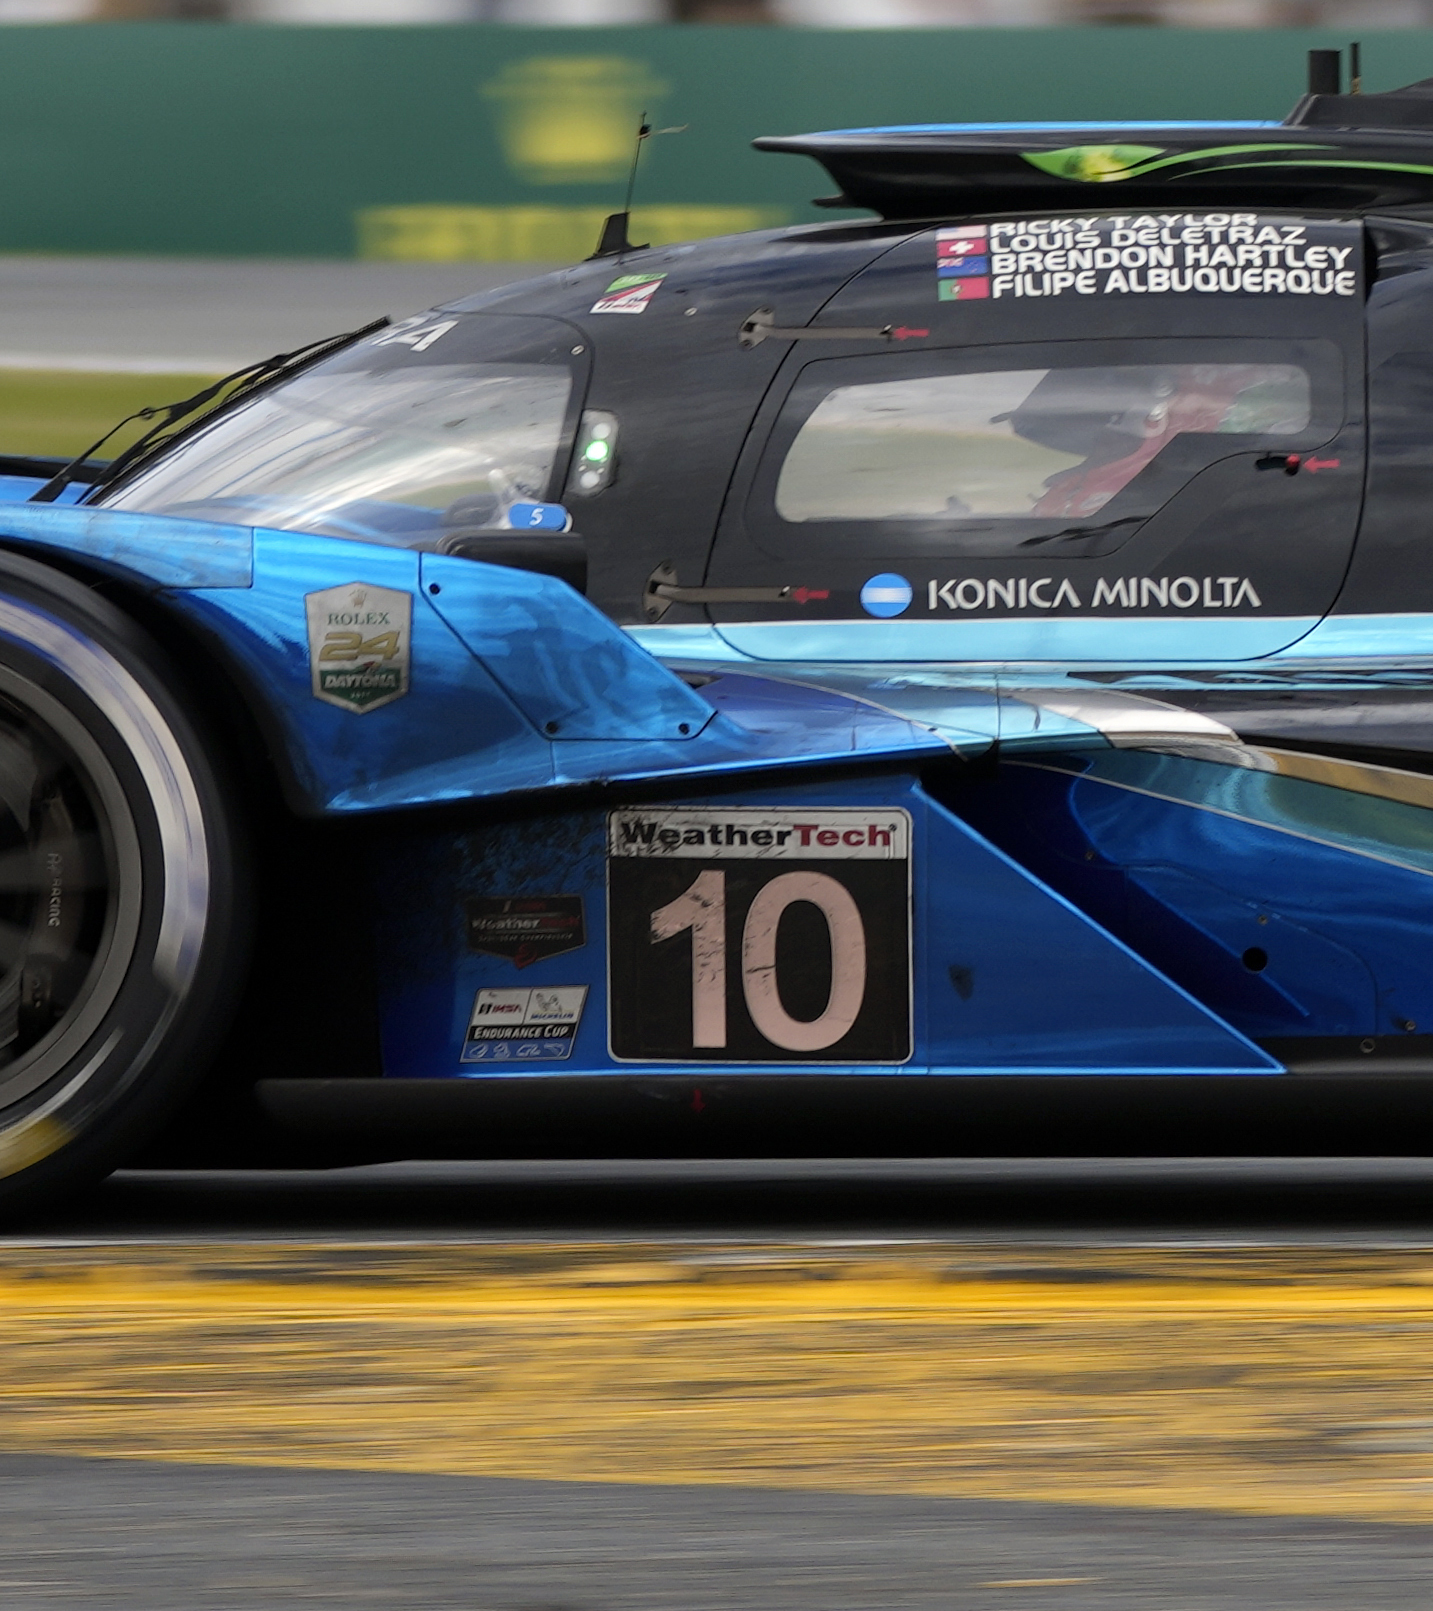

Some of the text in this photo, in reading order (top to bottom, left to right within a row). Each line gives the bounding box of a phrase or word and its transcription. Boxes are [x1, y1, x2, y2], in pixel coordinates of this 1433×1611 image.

[990, 213, 1258, 237] RICKY TAYLOR
[990, 226, 1308, 254] LOUIS DELETRAZ
[992, 245, 1353, 275] BRENDON HARTLEY
[992, 268, 1356, 299] FILIPE ALBUQUERQUE
[529, 507, 544, 526] 5
[928, 576, 1262, 610] KONICA MINOLTA
[327, 612, 390, 626] ROLEX
[319, 630, 400, 662] 24
[621, 823, 893, 847] WeatherTech
[650, 869, 867, 1052] 10
